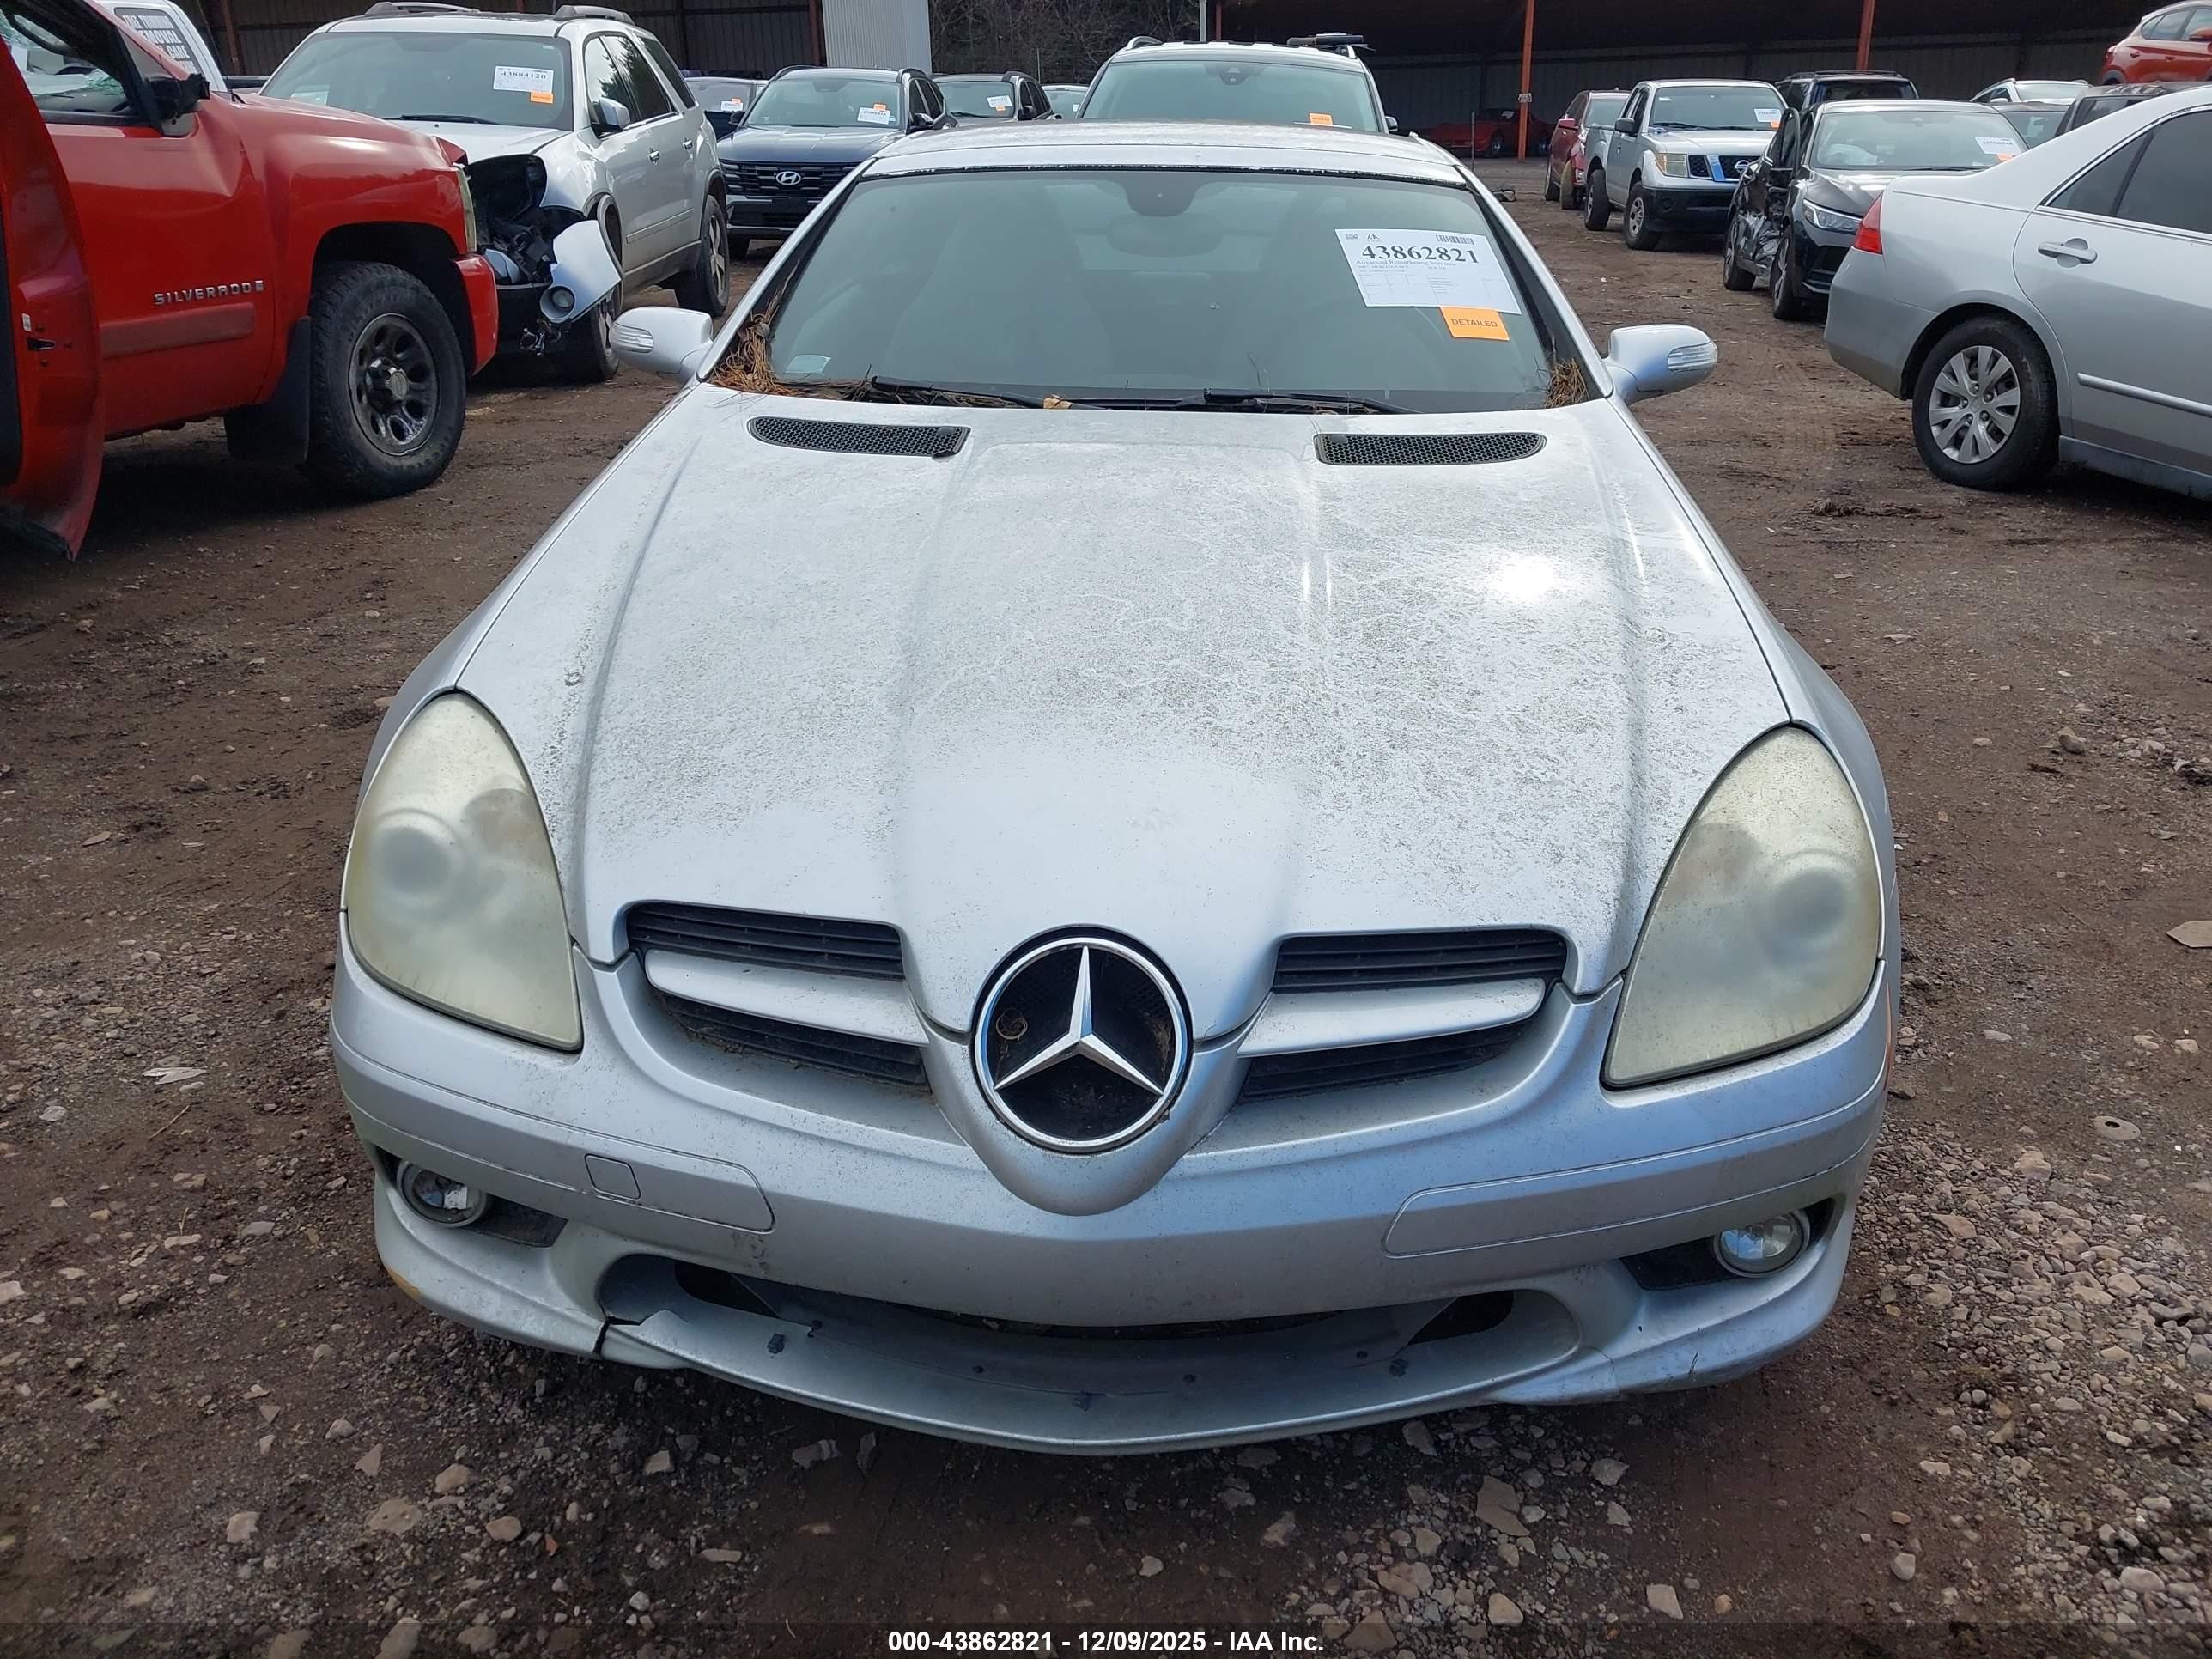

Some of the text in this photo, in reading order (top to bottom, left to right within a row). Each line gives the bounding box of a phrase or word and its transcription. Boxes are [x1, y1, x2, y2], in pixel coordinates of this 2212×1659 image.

[1362, 245, 1479, 264] 43862821
[154, 283, 251, 305] SILVERADO
[1450, 319, 1498, 327] DETAILED
